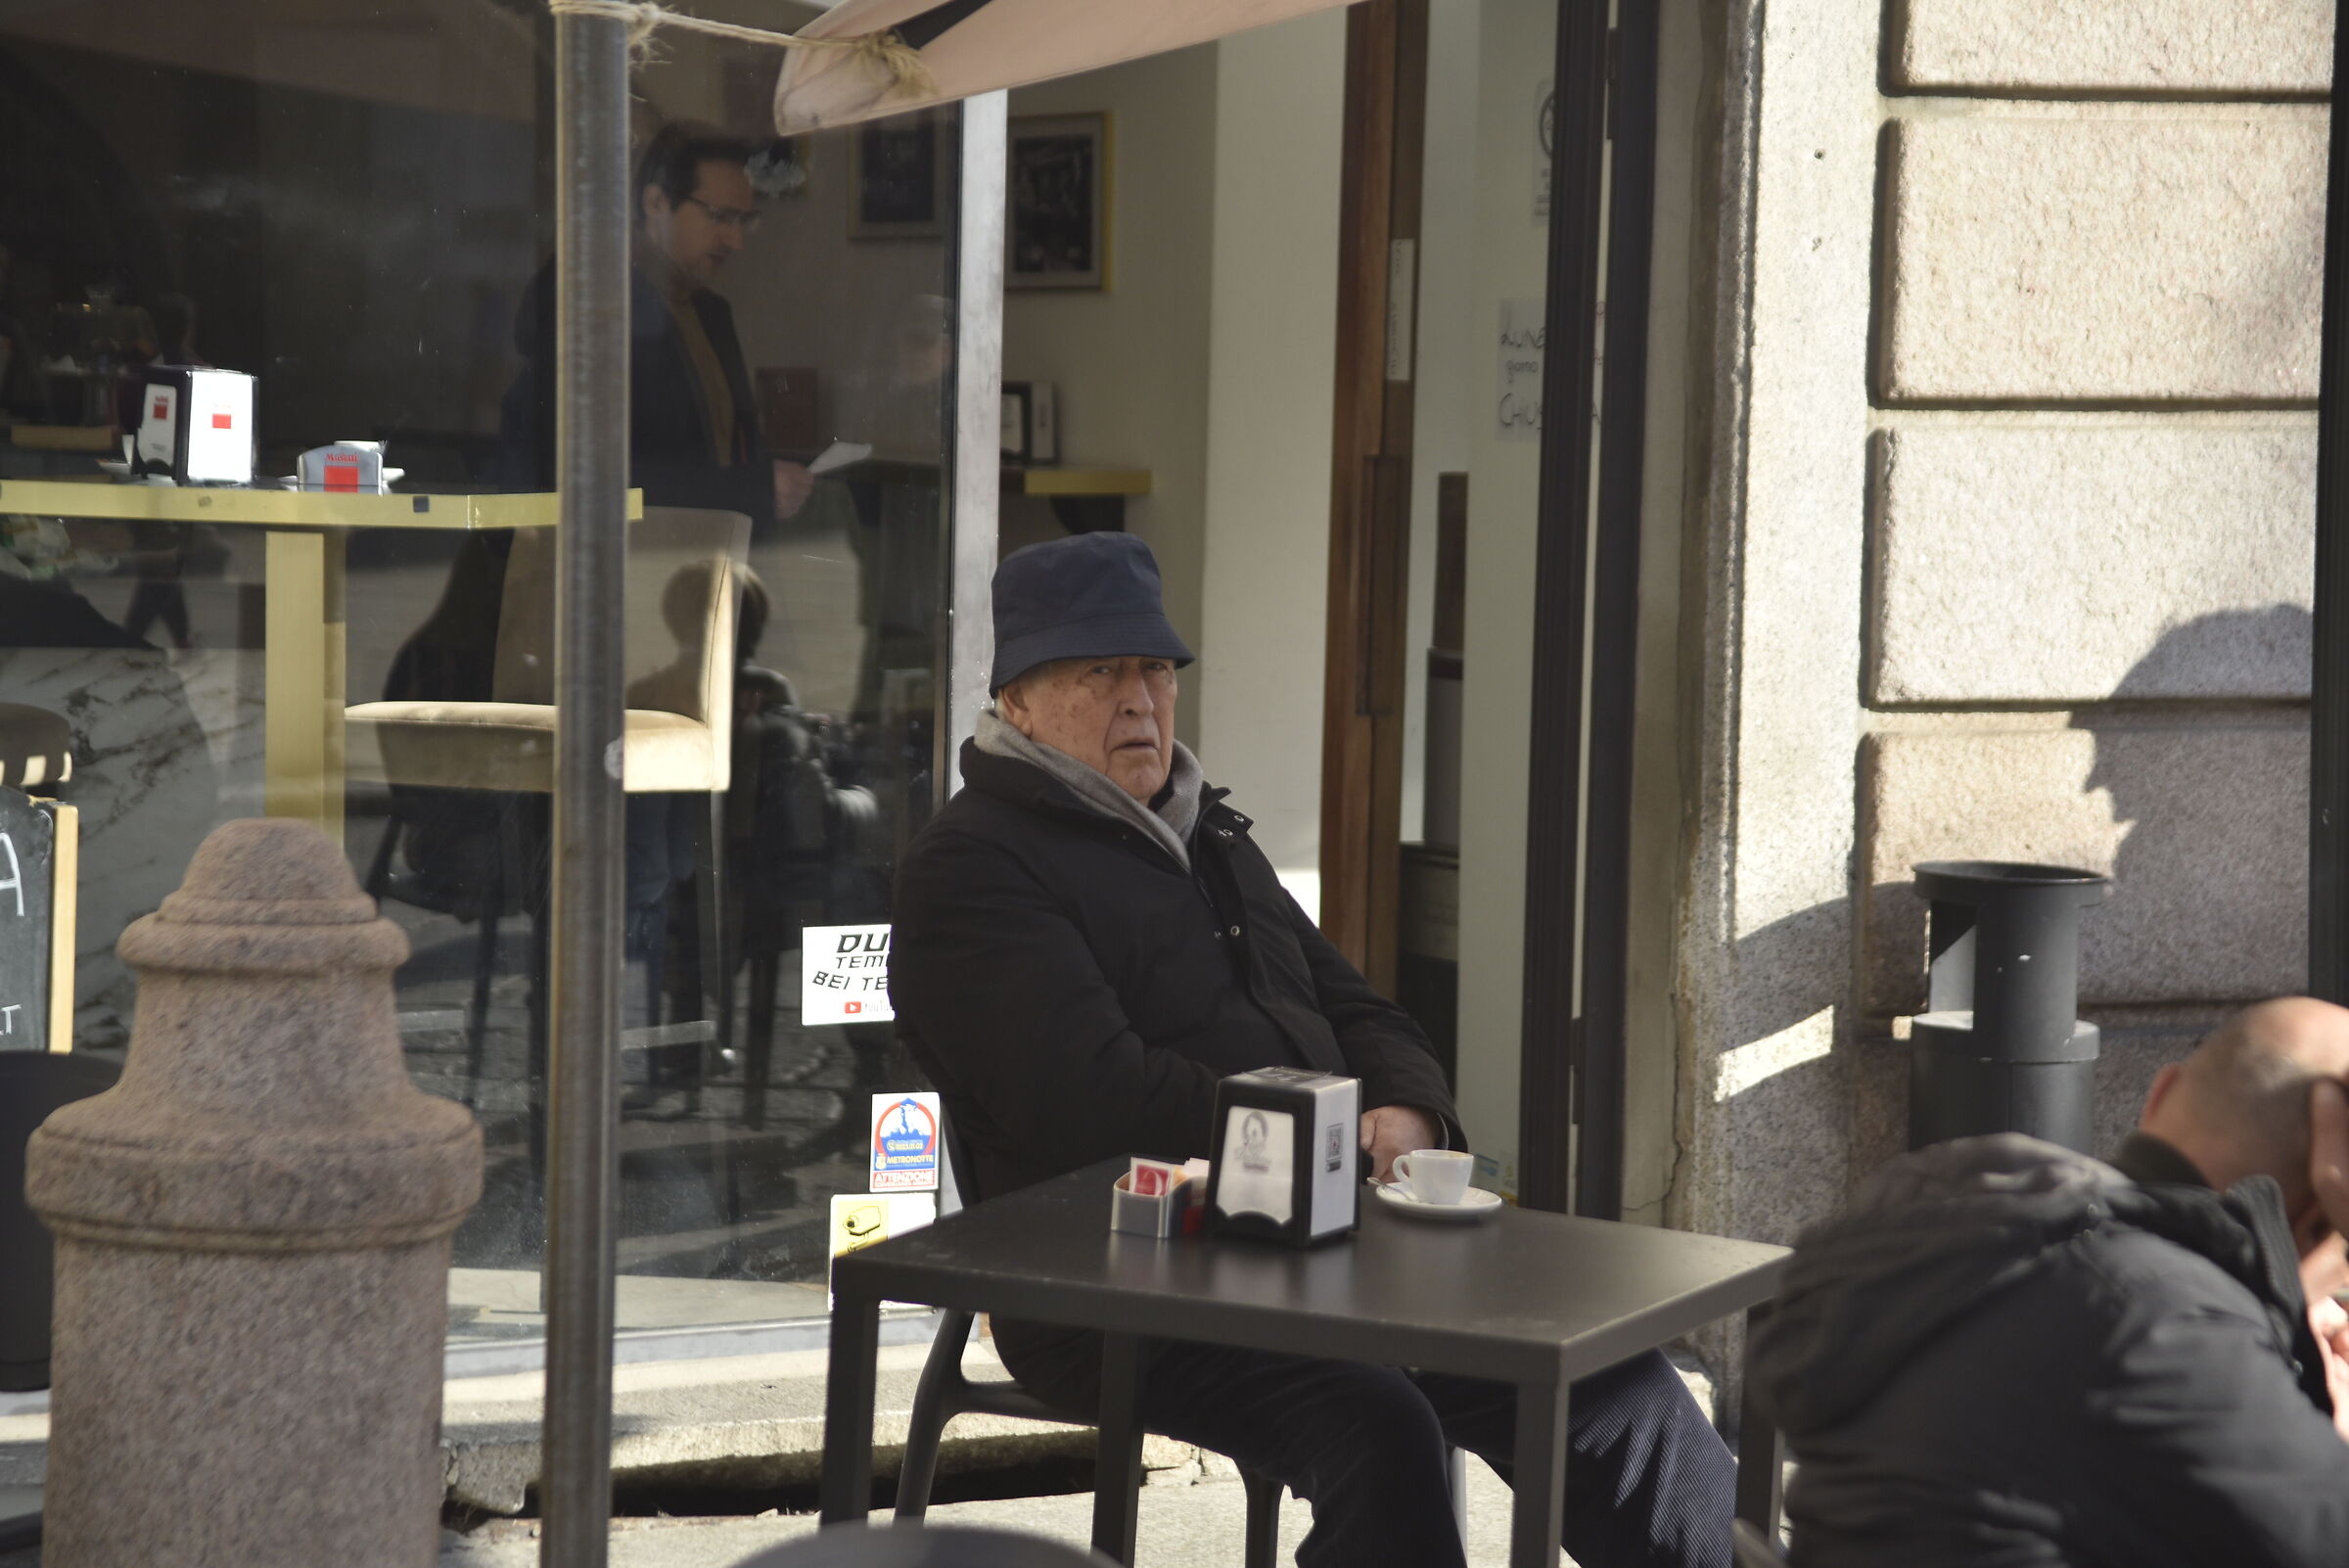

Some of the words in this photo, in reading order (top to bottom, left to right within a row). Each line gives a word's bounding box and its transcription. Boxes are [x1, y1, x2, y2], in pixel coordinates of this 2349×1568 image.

[812, 970, 851, 991] BEI
[887, 1154, 934, 1164] METRONOTTE
[874, 1171, 934, 1183] ATTENZIONE
